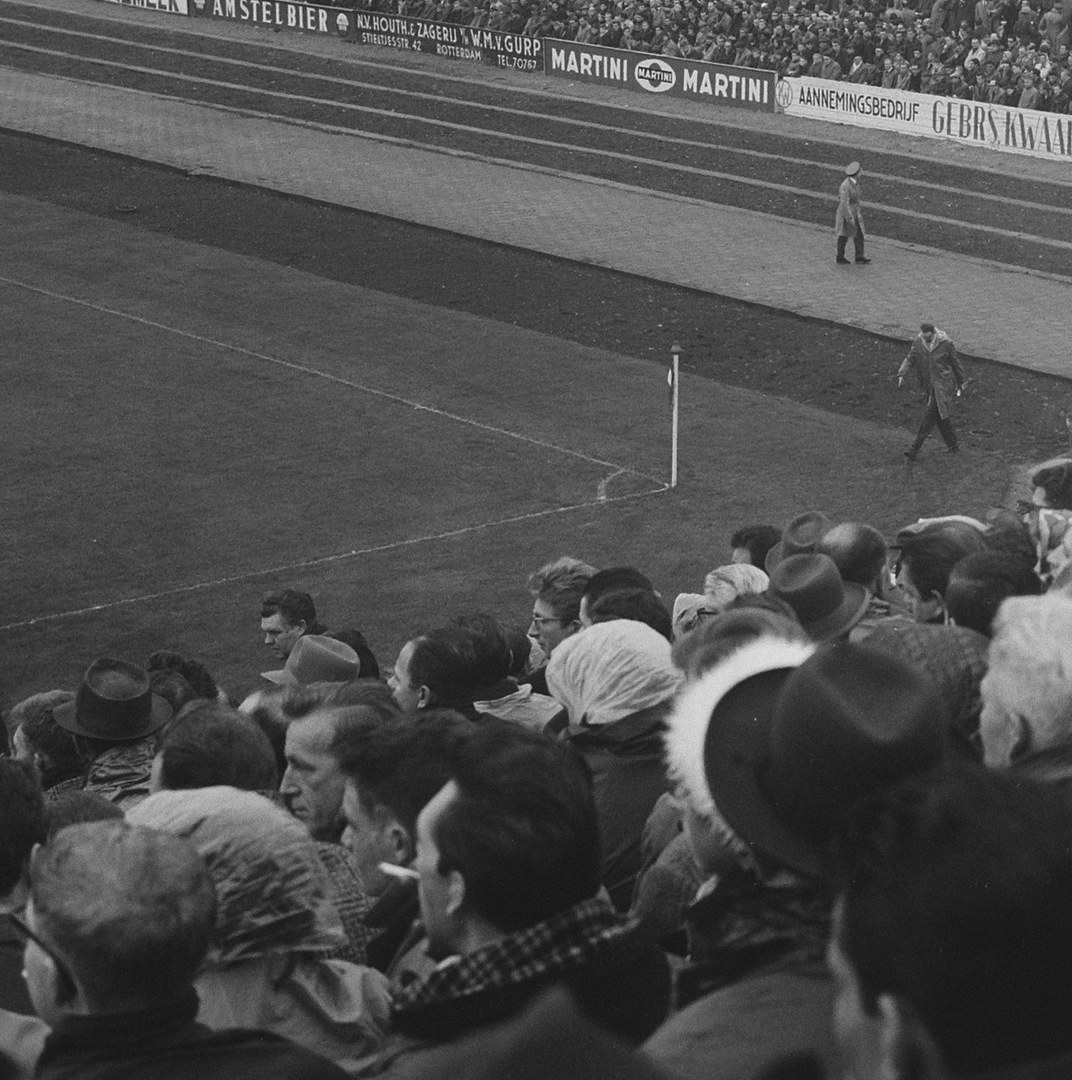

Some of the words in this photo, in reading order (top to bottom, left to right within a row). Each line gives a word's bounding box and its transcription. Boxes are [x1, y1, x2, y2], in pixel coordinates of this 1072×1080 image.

[417, 23, 458, 43] ZAGERIJ
[412, 40, 422, 52] 42
[436, 43, 482, 61] ROTTERDAM
[551, 47, 628, 82] MARTINI
[638, 68, 673, 83] MARTINI
[683, 68, 769, 104] MARTINI
[799, 86, 920, 123] AANNEMINGSBEDRIJF
